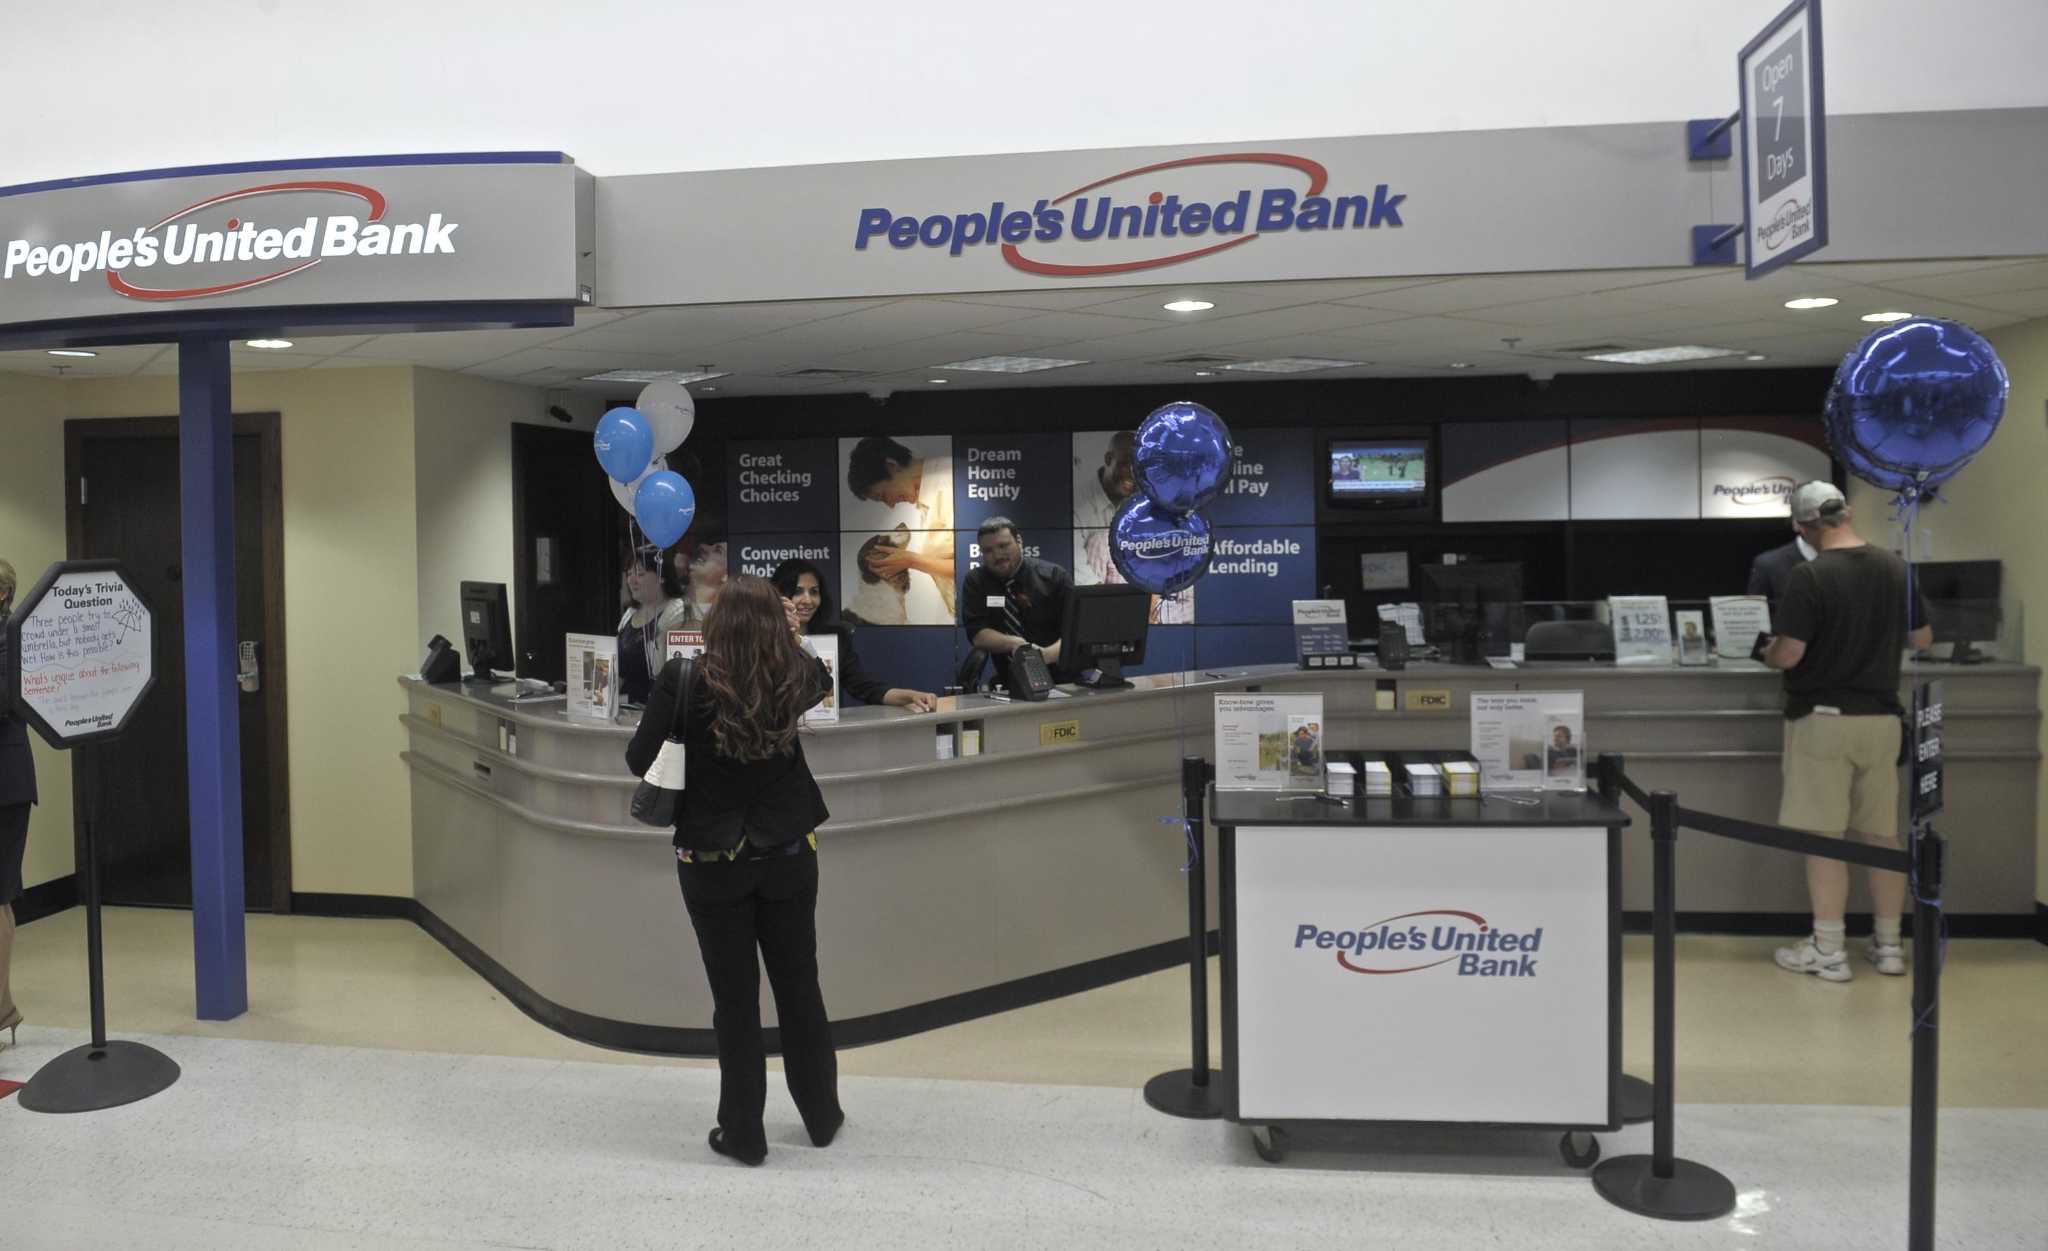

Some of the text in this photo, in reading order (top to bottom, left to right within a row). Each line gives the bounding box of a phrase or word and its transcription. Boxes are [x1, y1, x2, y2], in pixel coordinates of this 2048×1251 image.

[1761, 53, 1793, 92] Open
[1772, 95, 1785, 142] 7
[1767, 147, 1794, 181] Days
[855, 184, 1407, 256] People's United Bank
[1786, 203, 1811, 227] United
[1792, 219, 1810, 240] Bank
[4, 214, 459, 282] People's United Bank
[739, 453, 782, 467] Great
[967, 448, 1021, 461] Dream
[740, 469, 812, 487] Checking
[967, 466, 1016, 480] Home
[740, 488, 800, 502] Choices
[967, 483, 1020, 501] Equity
[1238, 479, 1269, 497] Pay
[1713, 484, 1770, 497] People's
[741, 545, 830, 560] Convenient
[1120, 534, 1209, 553] People's United
[1183, 545, 1209, 557] Bank
[1208, 558, 1279, 577] Lending
[51, 582, 123, 598] Today's Trivia
[64, 598, 113, 610] Question
[32, 615, 53, 628] Three
[58, 611, 84, 629] people
[21, 631, 45, 643] crowd
[48, 627, 70, 639] under
[59, 637, 72, 648] but
[670, 635, 694, 644] ENTER
[78, 667, 98, 680] about
[1420, 695, 1446, 705] FDIC
[92, 713, 114, 724] United
[1917, 703, 1943, 728] PLEASE
[1054, 726, 1076, 738] FDIC
[1919, 737, 1940, 763] ENTER
[1920, 771, 1938, 795] HERE
[1295, 924, 1543, 955] People's United
[1458, 953, 1539, 977] Bank
